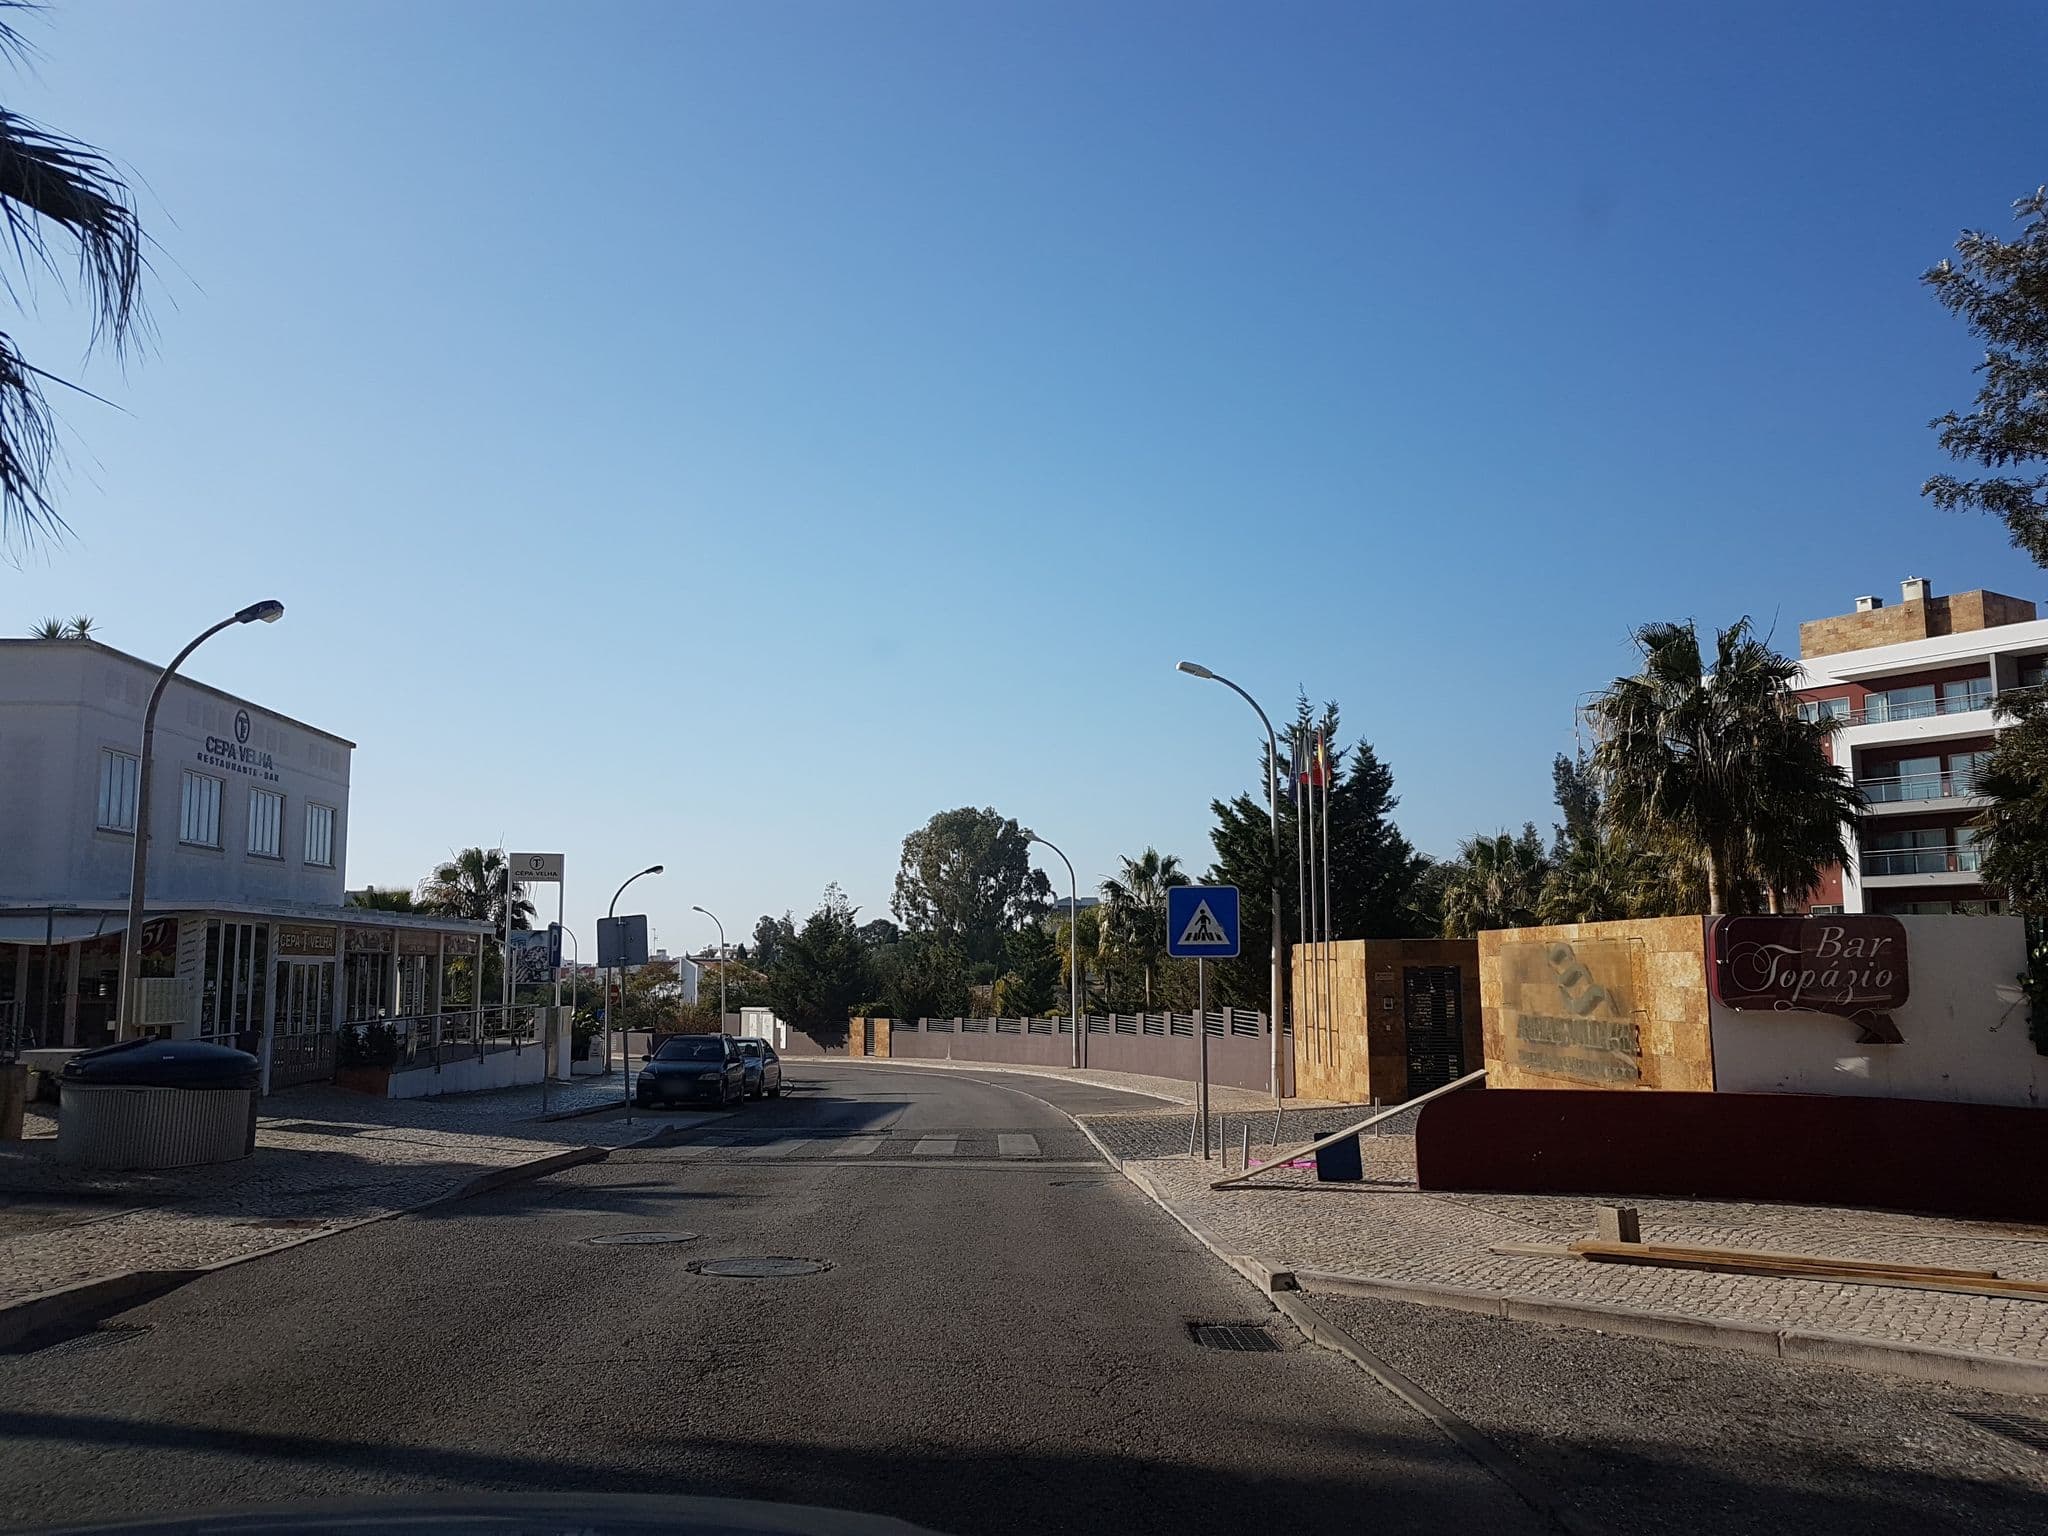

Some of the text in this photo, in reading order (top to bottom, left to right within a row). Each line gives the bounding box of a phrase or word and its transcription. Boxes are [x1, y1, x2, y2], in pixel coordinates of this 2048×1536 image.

[197, 752, 257, 777] RESTAURANTE
[206, 736, 273, 770] CEPA VELHA
[280, 934, 300, 948] CEPA
[310, 935, 333, 949] VELHA
[551, 929, 559, 962] P
[1815, 926, 1893, 959] Bar
[1732, 944, 1894, 1006] Topázio
